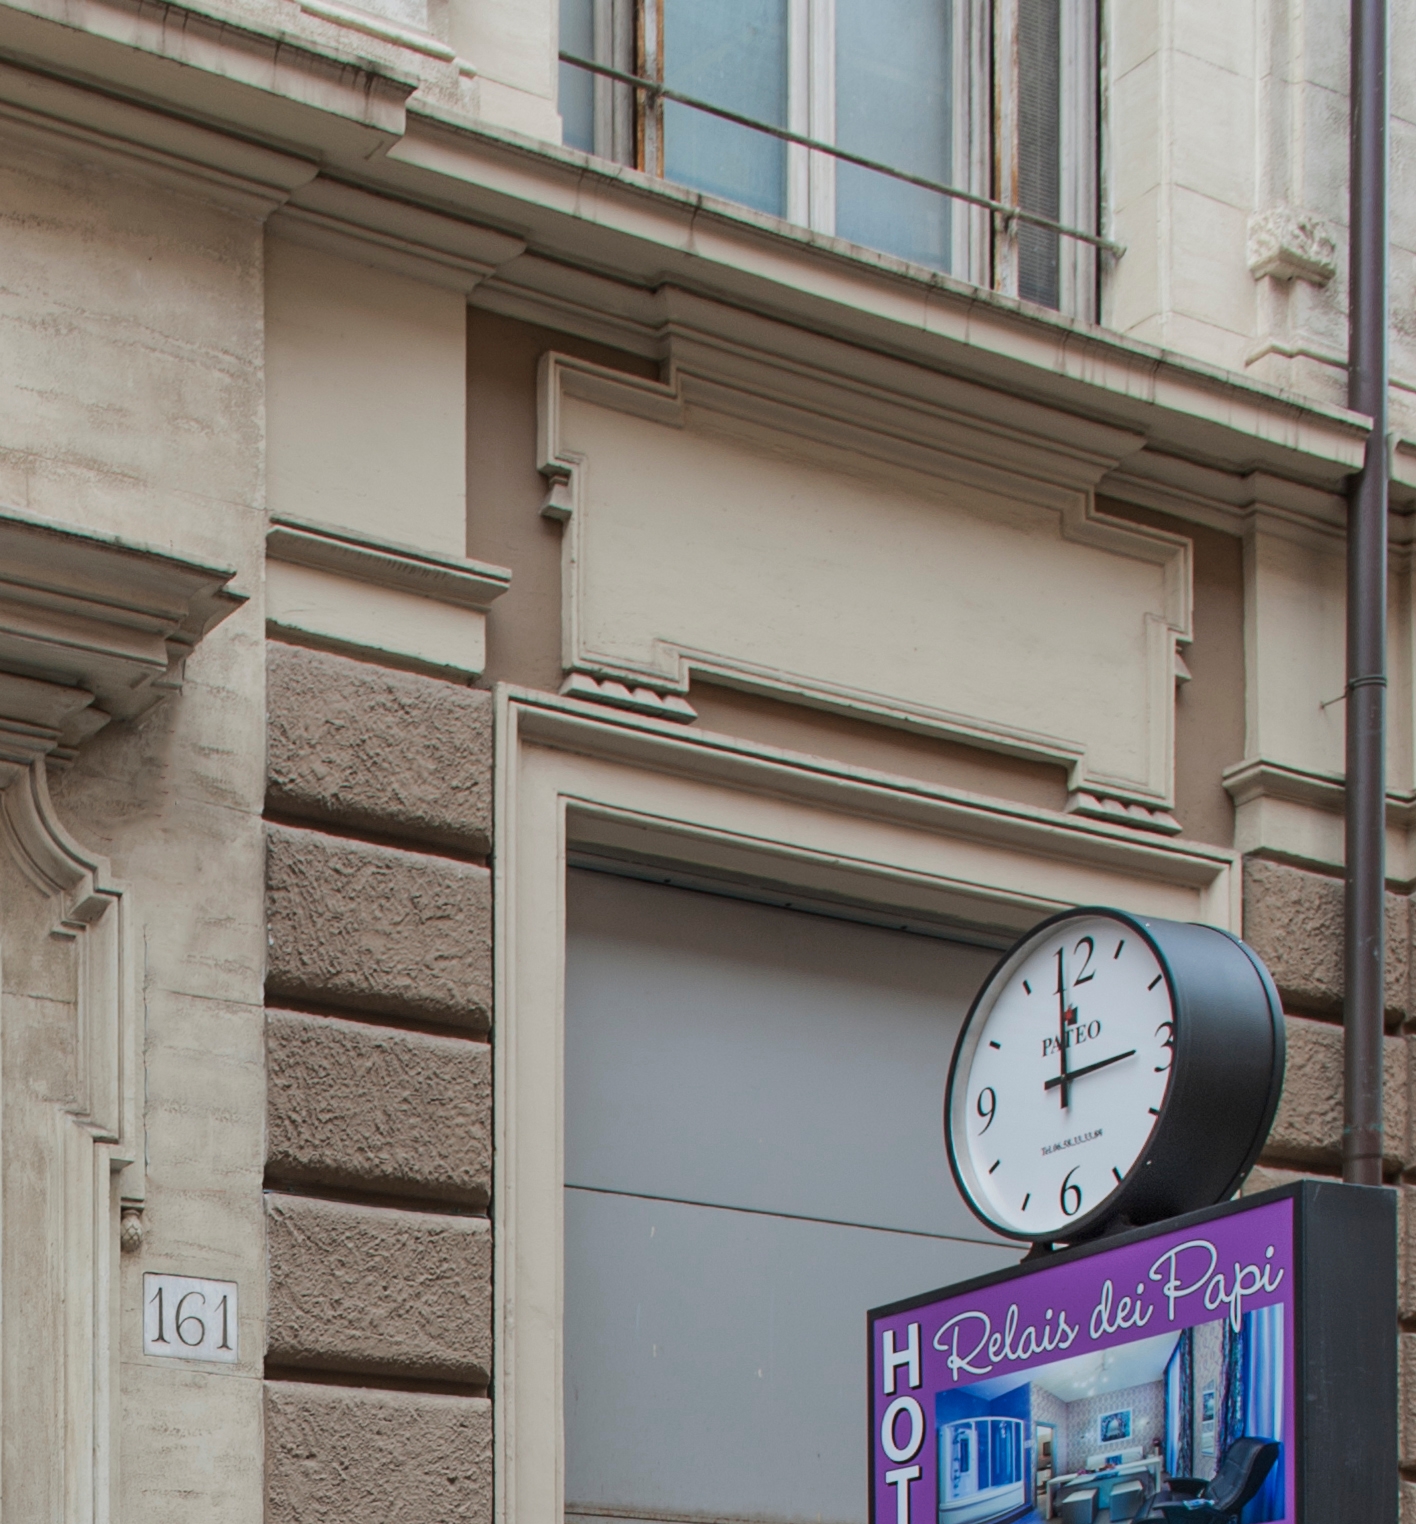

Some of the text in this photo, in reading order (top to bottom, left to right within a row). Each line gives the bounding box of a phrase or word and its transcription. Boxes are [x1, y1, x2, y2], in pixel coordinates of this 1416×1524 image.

[1053, 936, 1097, 996] 12
[1042, 1019, 1101, 1057] PATEO
[1154, 1021, 1174, 1072] 3
[976, 1086, 997, 1136] 9
[1060, 1165, 1082, 1216] 6
[149, 1286, 233, 1351] 161
[933, 1240, 1284, 1381] Relais dei Papi
